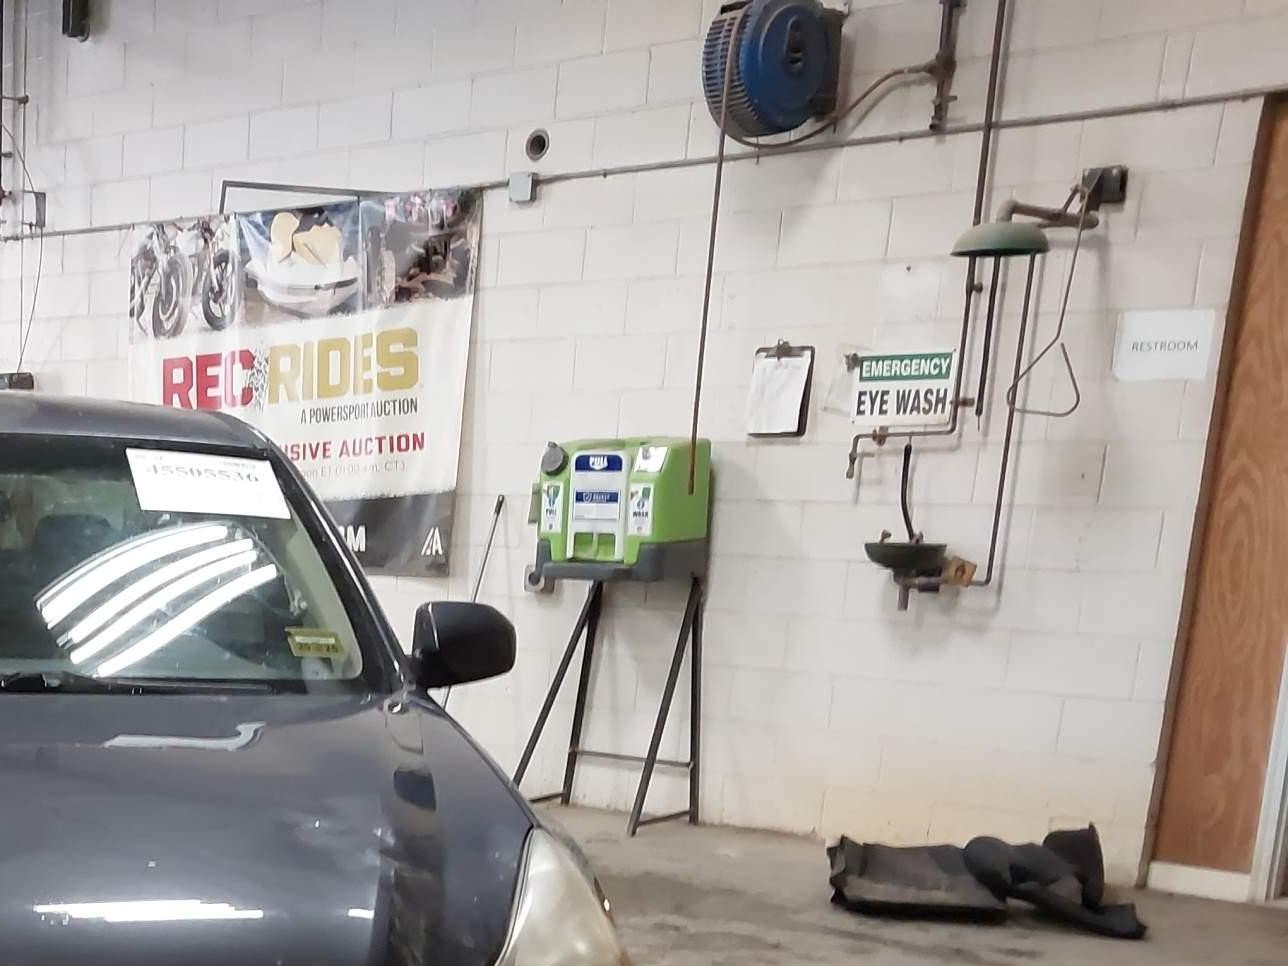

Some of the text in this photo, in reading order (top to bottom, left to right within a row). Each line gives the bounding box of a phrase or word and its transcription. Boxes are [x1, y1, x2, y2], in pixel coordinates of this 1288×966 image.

[1131, 340, 1199, 353] RESTROOM
[268, 327, 420, 405] RIDES
[861, 357, 951, 378] EMERGENCY
[370, 397, 419, 419] AUCTION
[855, 387, 949, 417] EYE WASH
[338, 431, 426, 459] AUCTION
